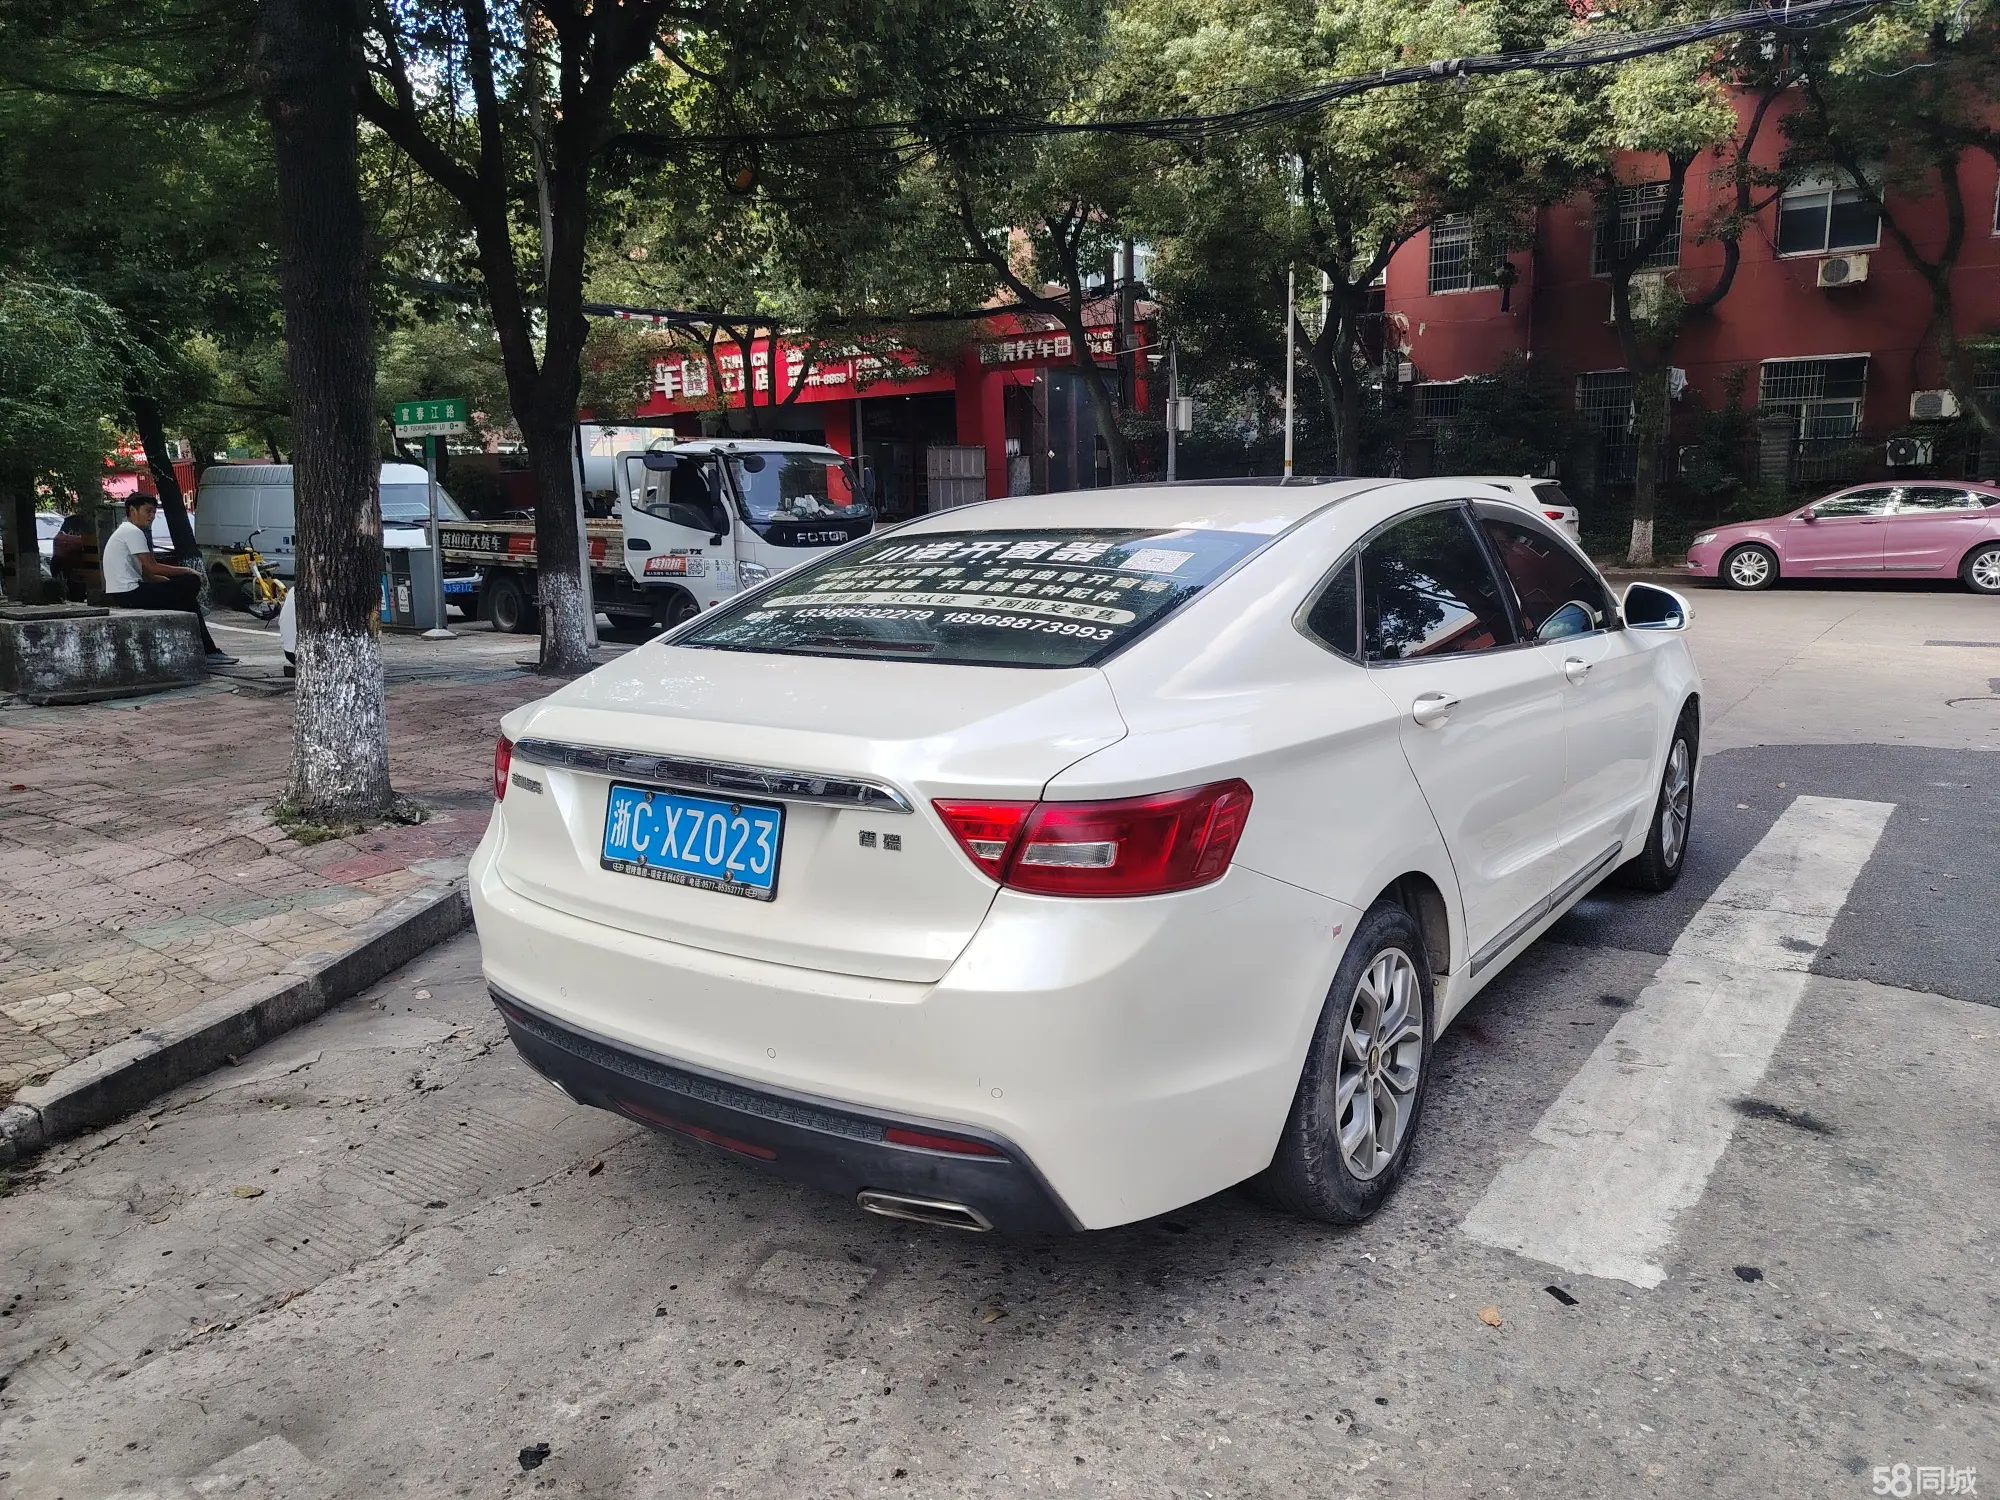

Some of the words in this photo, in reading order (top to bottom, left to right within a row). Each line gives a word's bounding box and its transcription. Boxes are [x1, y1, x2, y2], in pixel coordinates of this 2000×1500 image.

[402, 405, 454, 421] 富春江路
[442, 532, 500, 550] 货拉拉大货车
[974, 597, 1118, 621] 全国批发零售
[792, 609, 934, 621] 13388532279
[942, 612, 1114, 641] 18968873993
